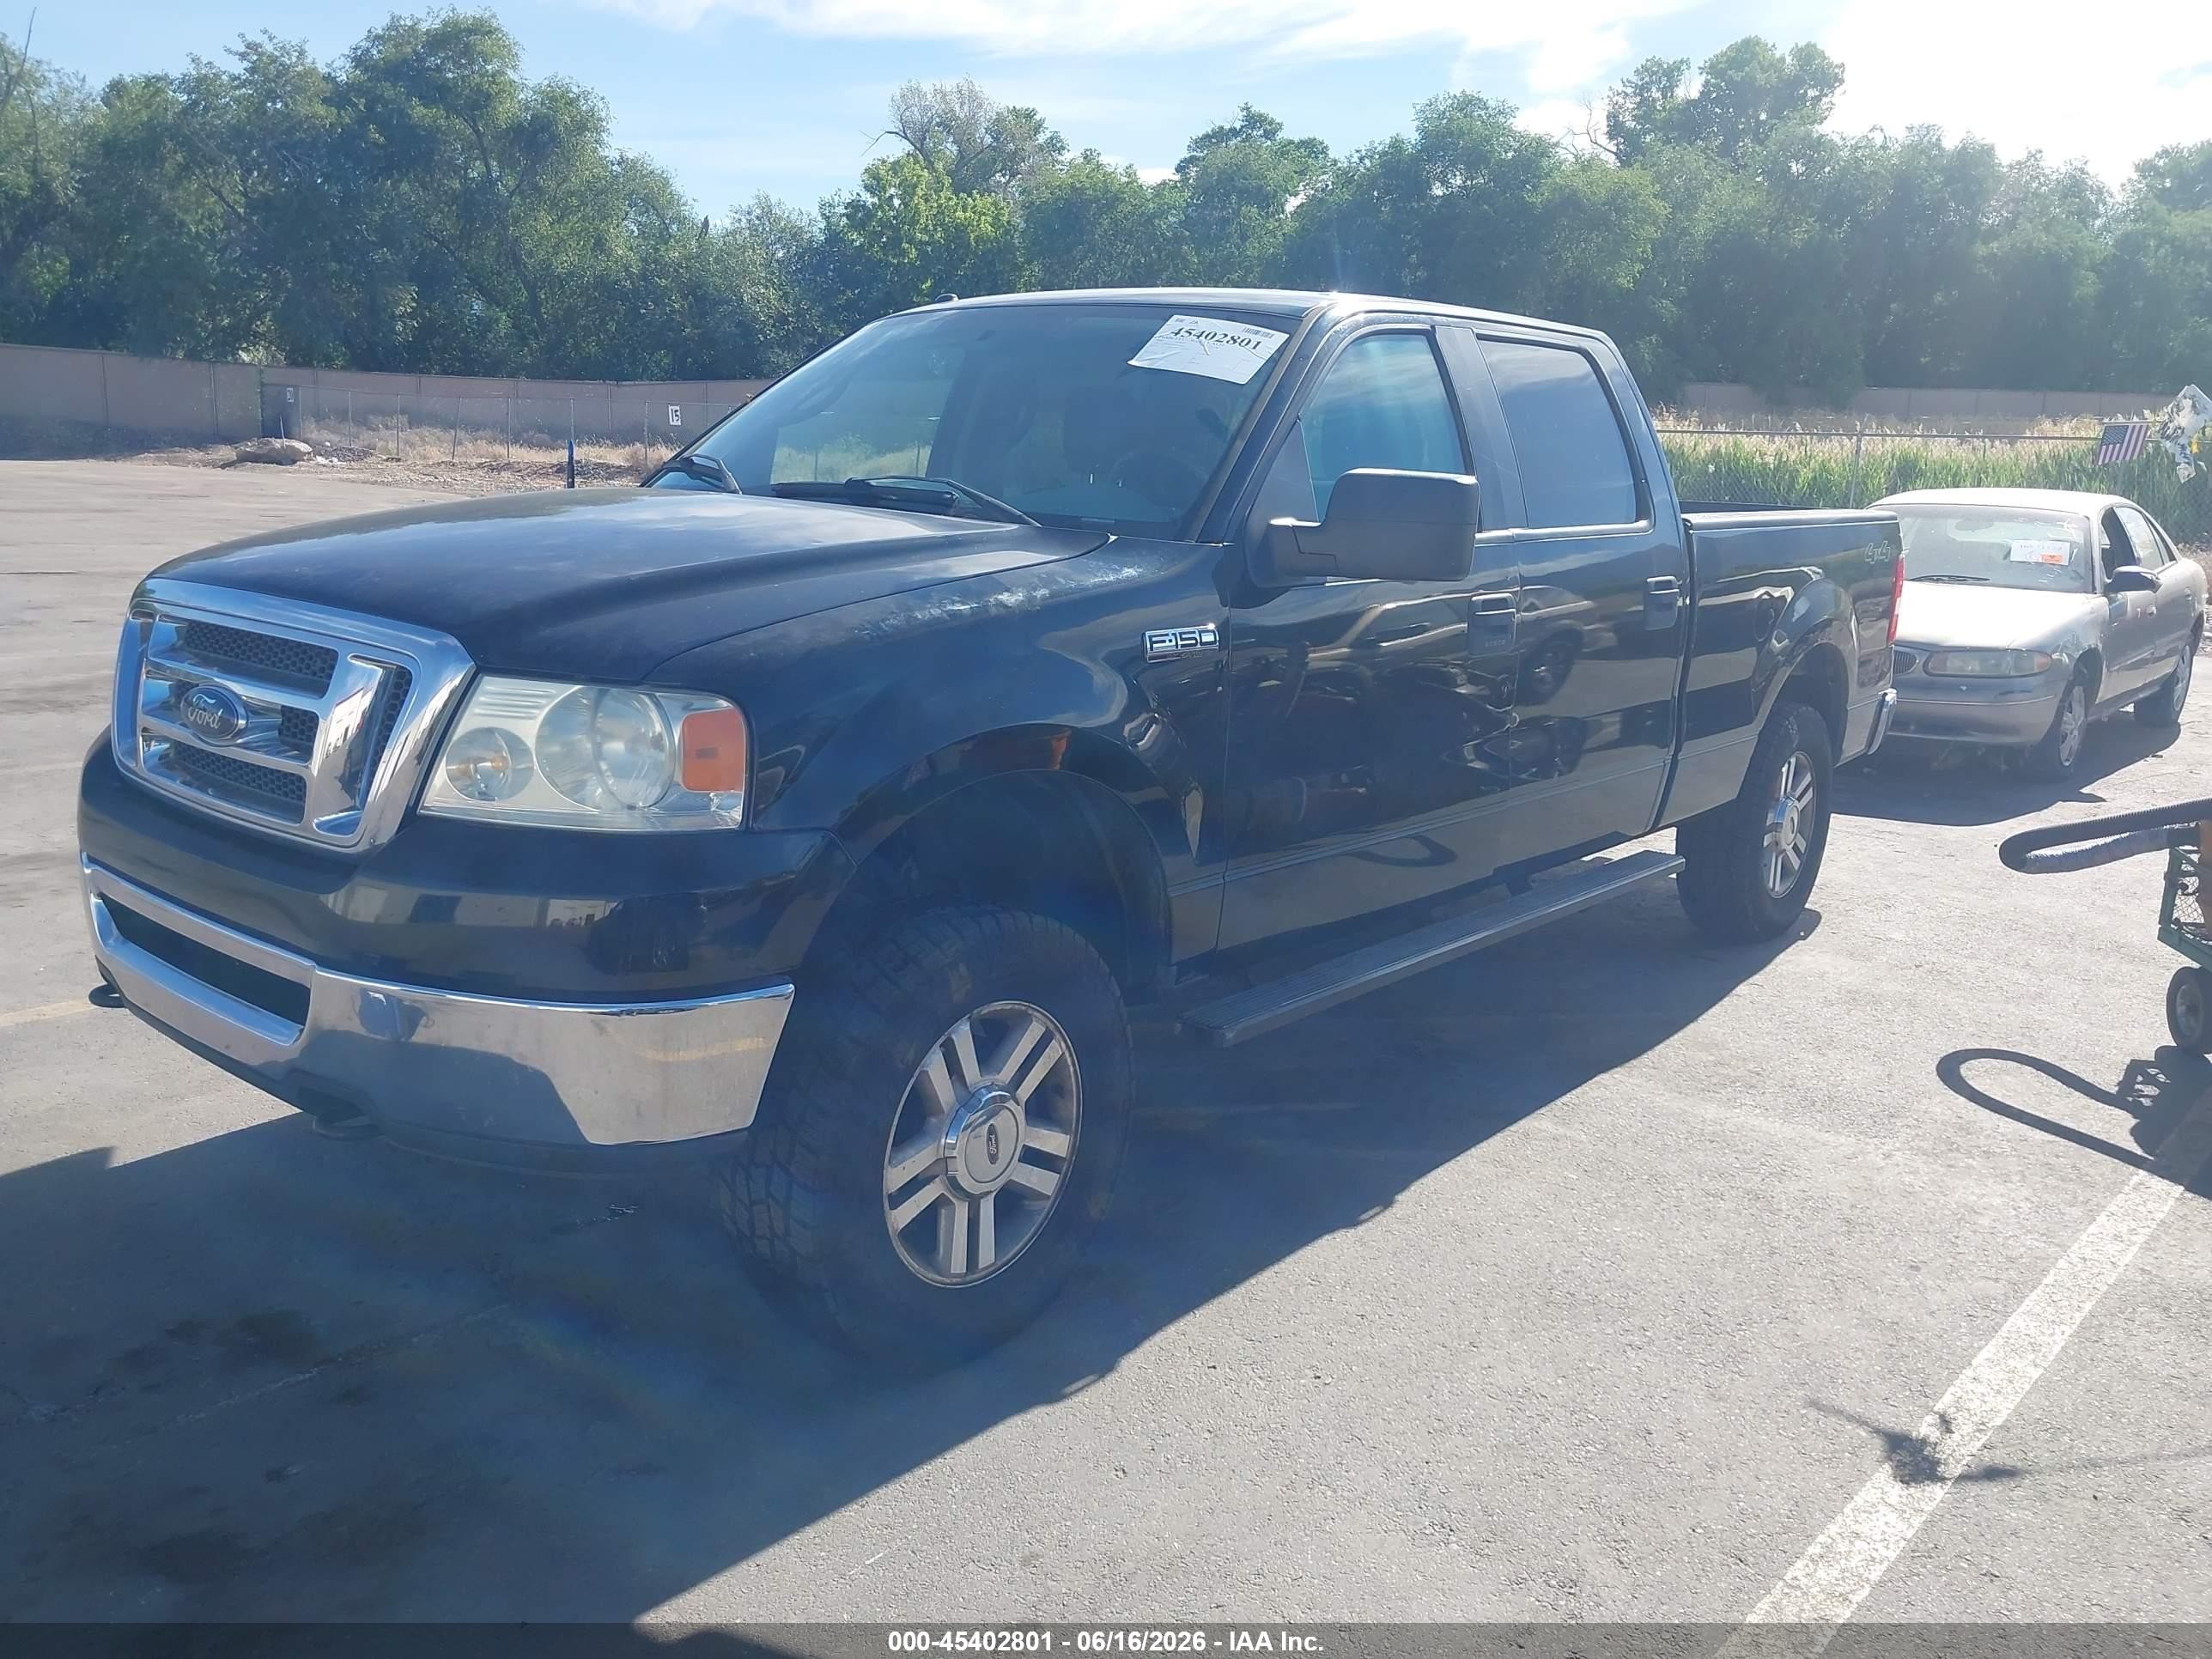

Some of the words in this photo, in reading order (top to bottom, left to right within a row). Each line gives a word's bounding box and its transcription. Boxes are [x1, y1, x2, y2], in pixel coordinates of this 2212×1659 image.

[1170, 327, 1262, 350] 45402801
[671, 408, 680, 422] 15
[187, 693, 223, 730] Ford
